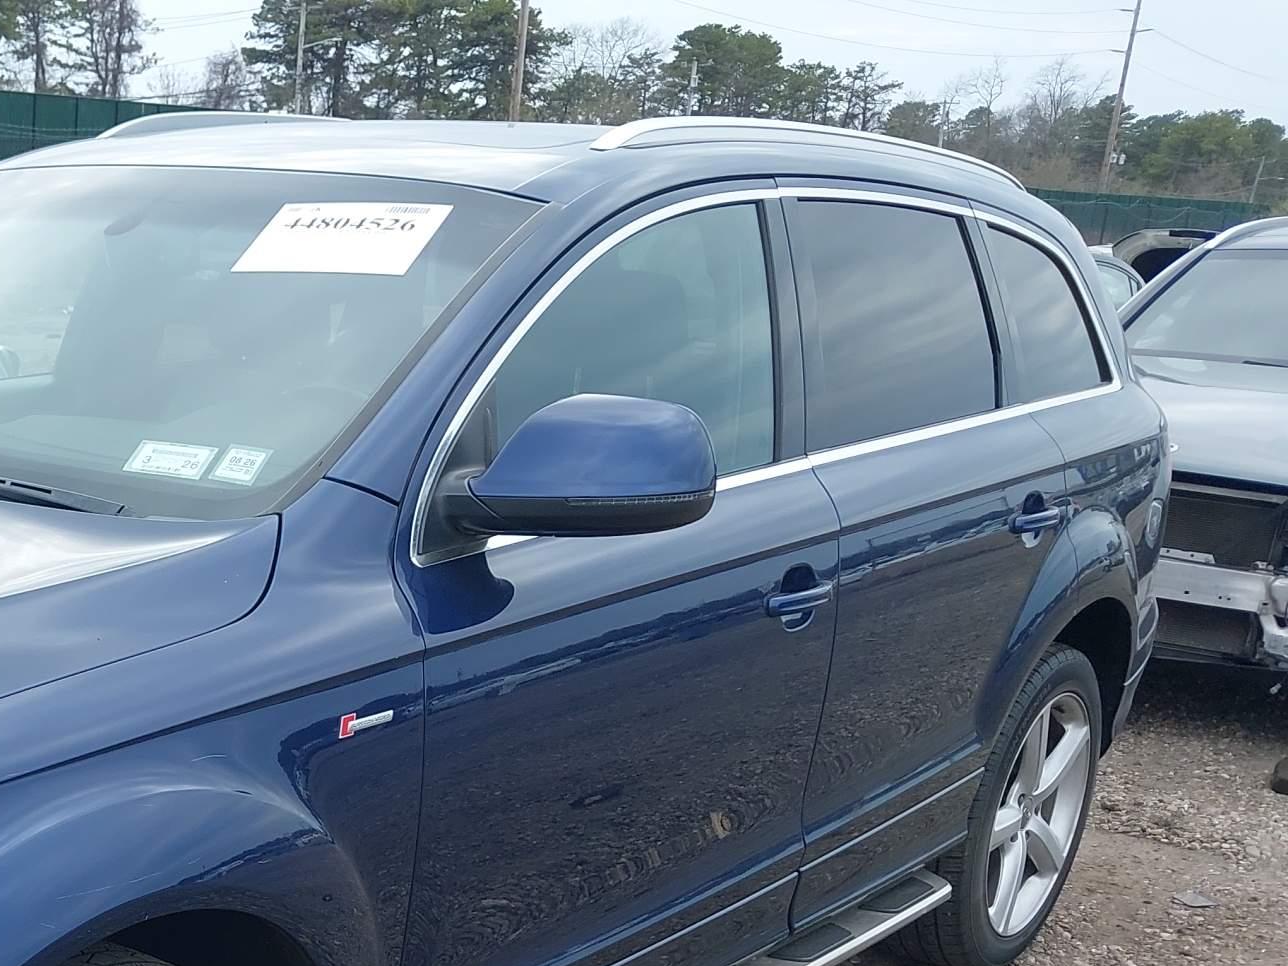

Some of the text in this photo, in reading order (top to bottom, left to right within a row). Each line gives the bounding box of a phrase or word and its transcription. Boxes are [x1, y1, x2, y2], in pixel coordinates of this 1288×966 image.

[283, 217, 416, 232] 44804526
[181, 459, 200, 470] 26
[243, 458, 257, 467] 26
